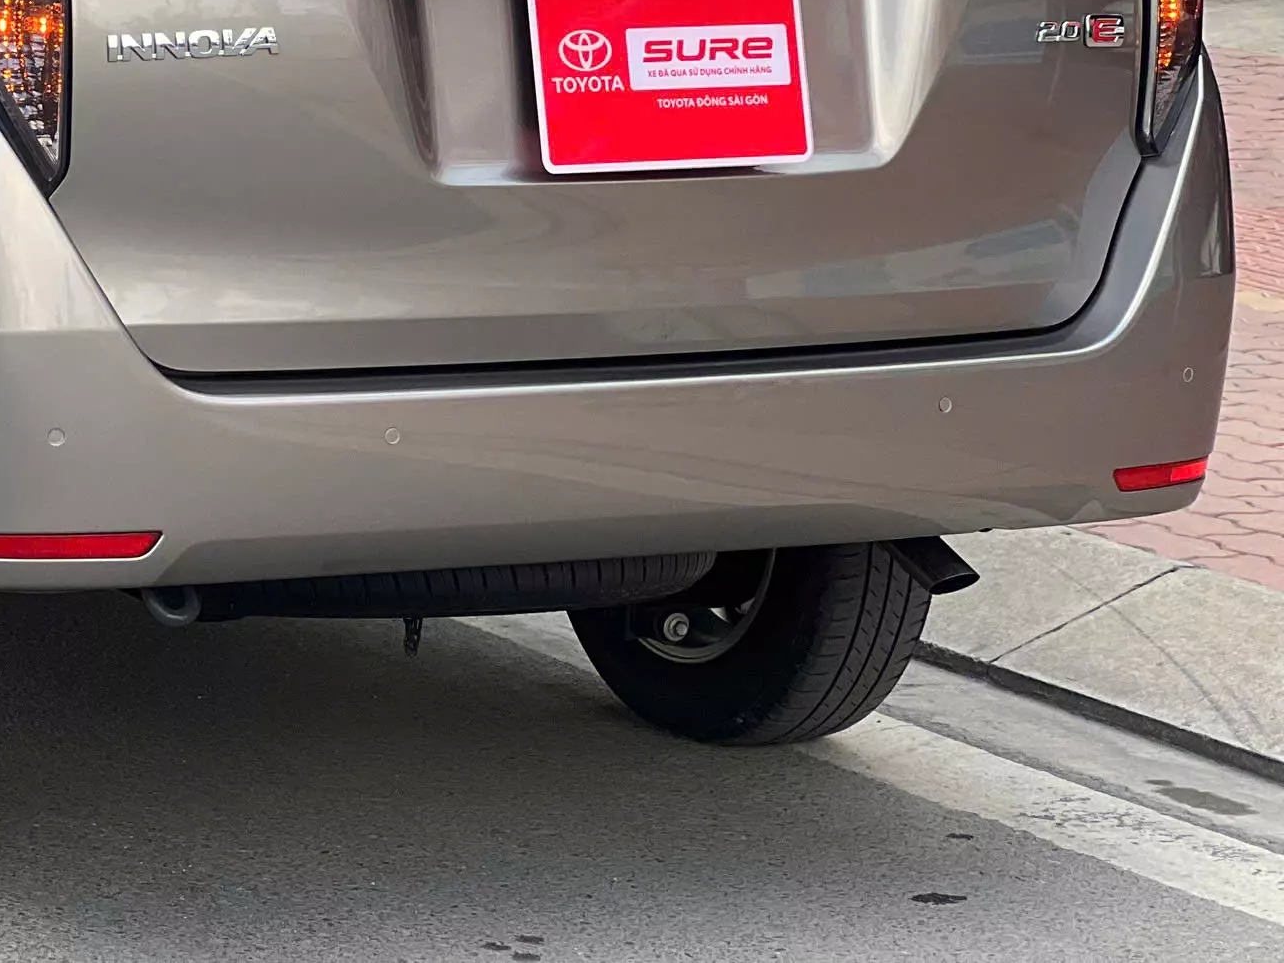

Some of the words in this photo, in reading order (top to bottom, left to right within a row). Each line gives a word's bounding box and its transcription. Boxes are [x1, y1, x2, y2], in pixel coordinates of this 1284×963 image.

[107, 26, 280, 62] INNOVA
[647, 69, 658, 78] XE
[670, 68, 687, 78] QUA
[700, 67, 722, 78] DỤNG
[723, 65, 748, 76] CHÍNH
[749, 64, 772, 75] HÃNG
[551, 75, 625, 94] TOYOTA
[657, 97, 695, 109] TOYOTA
[696, 95, 727, 108] ĐÔNG
[728, 93, 744, 106] SÀI
[745, 92, 769, 106] GÒN
